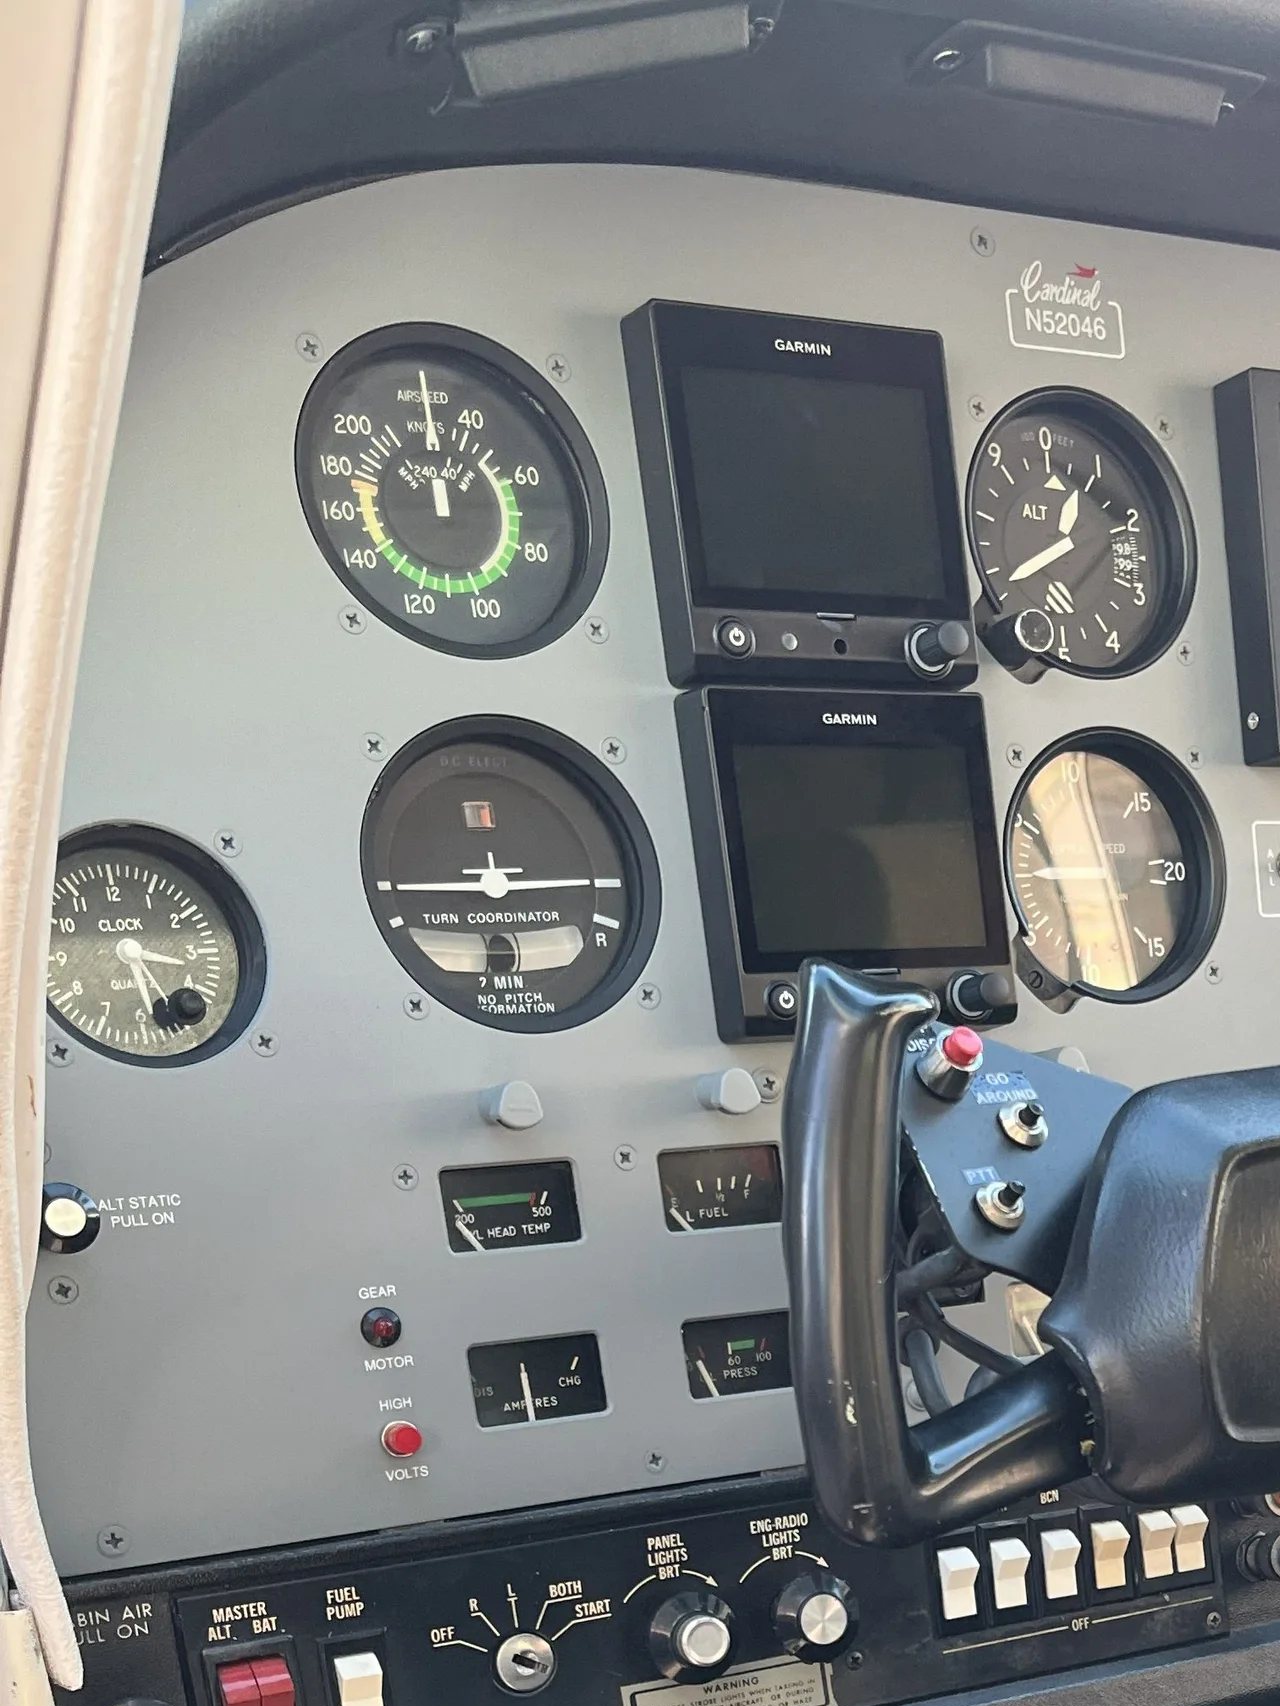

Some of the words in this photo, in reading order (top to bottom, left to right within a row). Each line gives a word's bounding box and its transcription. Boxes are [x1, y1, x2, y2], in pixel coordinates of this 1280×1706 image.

[1020, 260, 1101, 311] Cardinal
[1025, 307, 1107, 341] N52046
[775, 339, 832, 356] GARMIN
[397, 389, 449, 404] AIRSEED
[333, 413, 372, 436] 200
[458, 409, 484, 430] 40
[1039, 427, 1052, 451] 0
[988, 443, 1001, 467] 9
[321, 455, 352, 476] 180
[414, 465, 437, 479] 240
[398, 466, 420, 491] MPH
[441, 468, 457, 481] 40
[458, 469, 476, 493] MPH
[514, 465, 540, 486] 60
[322, 500, 355, 521] 160
[1022, 503, 1048, 521] ALT
[1126, 508, 1140, 533] 2
[344, 548, 377, 570] 140
[524, 542, 549, 563] 80
[1133, 583, 1146, 606] 3
[405, 594, 436, 615] 120
[471, 598, 501, 618] 100
[1105, 630, 1121, 654] 4
[822, 713, 877, 727] GARMIN
[1061, 761, 1080, 784] 10
[1134, 791, 1151, 813] 15
[1163, 861, 1186, 881] 20
[106, 886, 121, 902] 12
[73, 897, 87, 912] 11
[59, 918, 75, 933] 10
[98, 918, 143, 932] CLOCK
[170, 913, 181, 928] 2
[423, 914, 459, 924] TURN
[467, 911, 560, 924] COORDINATOR
[595, 932, 608, 947] R
[1148, 937, 1166, 958] 15
[55, 951, 68, 967] 9
[185, 945, 197, 960] 3
[72, 981, 83, 996] 8
[493, 975, 524, 990] MIN
[477, 994, 497, 1006] NO
[505, 992, 543, 1004] PITCH
[100, 1001, 111, 1017] 7
[135, 1008, 146, 1023] 6
[985, 1072, 1009, 1086] GO
[976, 1088, 1037, 1105] AROUND
[965, 1168, 996, 1183] PTT
[98, 1198, 124, 1212] ALT
[129, 1193, 182, 1210] STATIC
[743, 1189, 750, 1199] F
[110, 1213, 148, 1229] PULL
[151, 1210, 175, 1226] ON
[531, 1205, 552, 1218] 500
[686, 1210, 695, 1223] L
[699, 1207, 729, 1219] FUEL
[487, 1225, 517, 1239] HEAD
[521, 1222, 552, 1236] TEMP
[358, 1284, 397, 1300] GEAR
[364, 1354, 415, 1372] MOTOR
[728, 1355, 742, 1366] 60
[755, 1350, 772, 1363] 100
[558, 1375, 582, 1388] CHG
[723, 1366, 759, 1380] PRESS
[379, 1396, 413, 1412] HIGH
[385, 1465, 430, 1482] VOLTS
[1039, 1489, 1059, 1504] BCN
[750, 1512, 809, 1535] ENG-RADIO
[647, 1534, 685, 1551] PANEL
[762, 1530, 801, 1548] LIGHTS
[648, 1548, 689, 1567] LIGHTS
[773, 1545, 794, 1561] BRT
[658, 1565, 681, 1581] BRT
[326, 1586, 361, 1603] FUEL
[506, 1584, 516, 1598] L
[549, 1581, 582, 1598] BOTH
[122, 1603, 153, 1620] AIR
[212, 1601, 268, 1623] MASTER
[327, 1603, 365, 1621] PUMP
[468, 1598, 479, 1612] R
[575, 1599, 612, 1617] START
[117, 1621, 149, 1639] ON
[207, 1624, 233, 1642] ALT
[252, 1617, 278, 1634] BAT
[1071, 1617, 1090, 1632] OFF
[430, 1626, 455, 1643] OFF
[703, 1676, 760, 1695] WARNING
